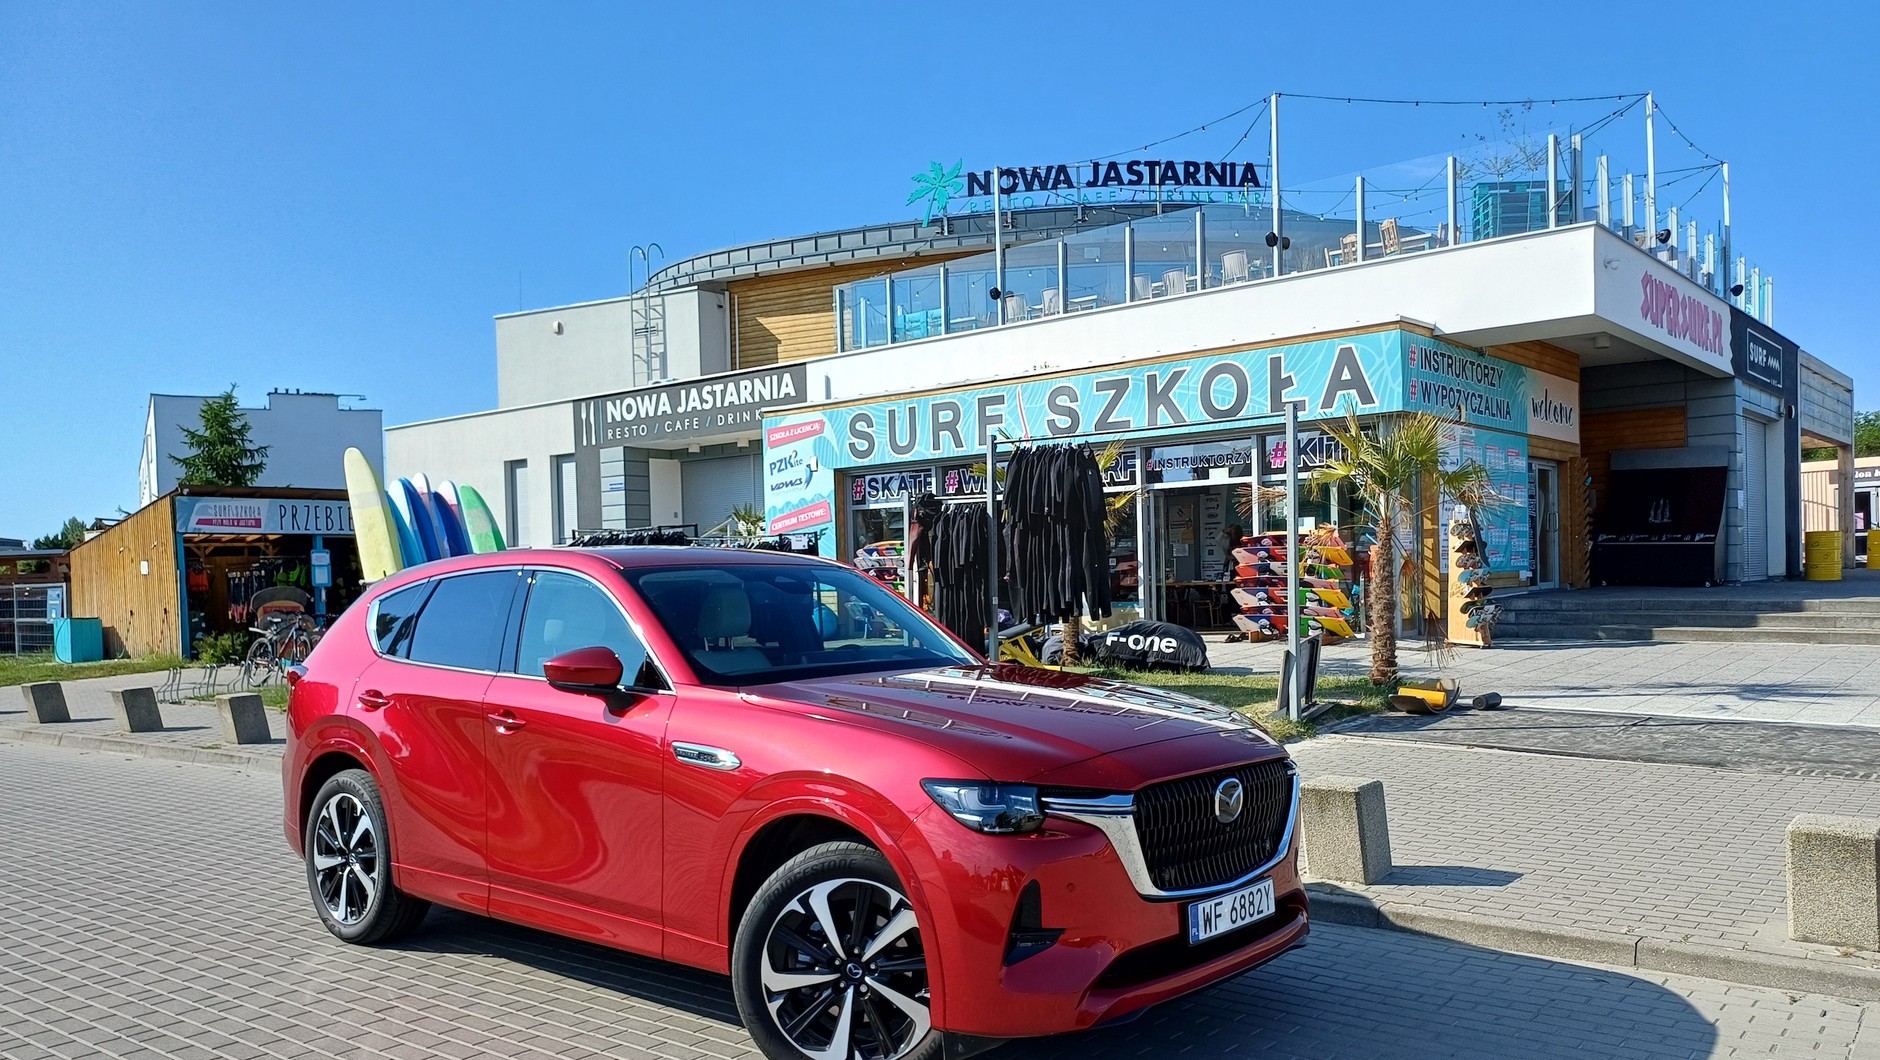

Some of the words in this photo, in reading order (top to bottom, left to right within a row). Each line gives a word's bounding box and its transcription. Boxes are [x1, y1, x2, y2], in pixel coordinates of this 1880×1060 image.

[968, 165, 1075, 197] NOWA
[1085, 160, 1261, 188] JASTARNIA
[970, 196, 1034, 213] RETO
[1063, 191, 1117, 205] CAFE
[1148, 190, 1215, 203] DRINK
[1225, 192, 1261, 204] BAR
[1749, 342, 1767, 367] SURF
[606, 392, 672, 423] NOWA
[676, 373, 796, 413] JASTARNIA
[847, 393, 1006, 461] SURF
[1046, 344, 1379, 437] SZKOŁA
[1531, 388, 1574, 427] welcome
[607, 424, 648, 441] RESTO
[664, 418, 700, 433] CAFE
[717, 409, 762, 426] DRINK
[1146, 451, 1251, 471] #INSTRUKTORZY
[278, 504, 355, 531] PRZEBIE
[1202, 901, 1223, 935] WF
[1229, 883, 1271, 925] 6882Y
[1191, 927, 1199, 937] PL
